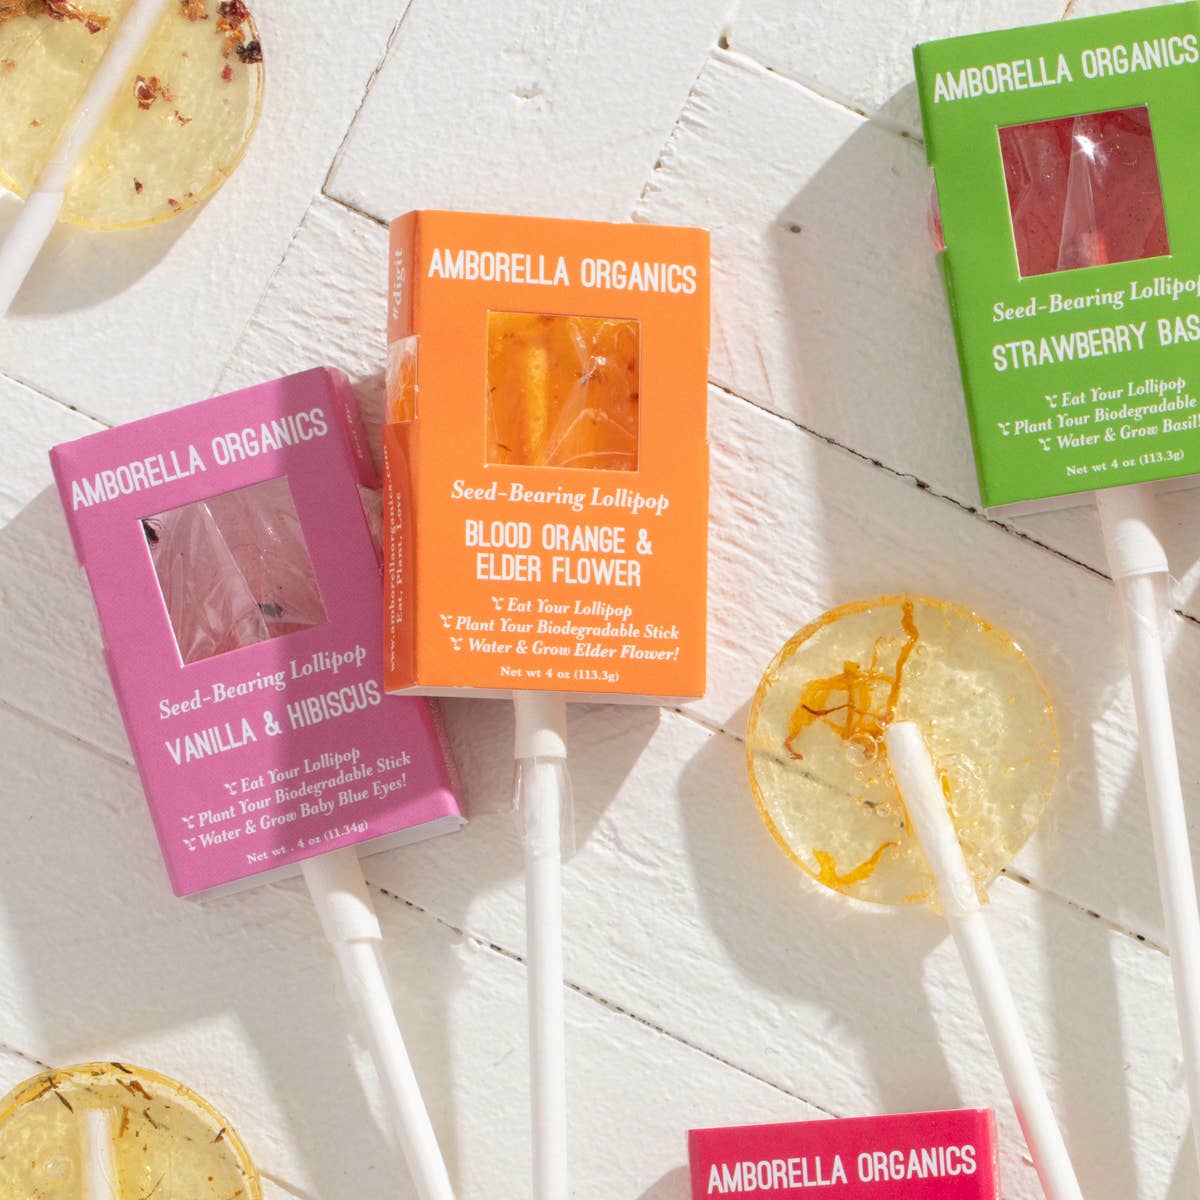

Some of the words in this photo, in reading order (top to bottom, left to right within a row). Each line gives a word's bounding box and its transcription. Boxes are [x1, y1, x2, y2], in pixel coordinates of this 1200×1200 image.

[933, 53, 1073, 104] AMBORELLA
[1080, 34, 1200, 80] ORGANICS
[427, 247, 570, 287] AMBORELLA
[580, 257, 697, 295] ORGANICS
[992, 288, 1126, 323] Seed-Bearing
[992, 321, 1147, 372] STRAWBERRY
[1061, 391, 1087, 408] Eat
[1090, 387, 1124, 403] Your
[1127, 376, 1187, 398] Lollipop
[1056, 433, 1101, 449] Water
[1103, 426, 1117, 443] &
[1119, 424, 1159, 440] Grow
[71, 444, 207, 511] AMBORELLA
[211, 407, 328, 466] ORGANICS
[450, 479, 587, 513] Seed-Bearing
[590, 486, 670, 517] Lollipop
[465, 519, 532, 549] BLOOD
[542, 523, 626, 555] ORANGE
[635, 527, 653, 555] &
[476, 552, 542, 582] ELDER
[552, 555, 641, 588] FLOWER
[468, 637, 513, 654] Water
[515, 639, 529, 655] &
[531, 640, 571, 657] Grow
[573, 642, 618, 659] Elder
[619, 644, 680, 661] Flower!
[159, 670, 287, 721] Seed-Bearing
[289, 644, 367, 680] Lollipop
[500, 666, 523, 678] Net
[526, 669, 542, 678] wt
[545, 668, 554, 679] 4
[556, 671, 571, 679] oz
[573, 669, 620, 684] (113.3g)
[164, 717, 258, 766] VANILLA
[262, 710, 283, 737] &
[286, 679, 382, 730] HIBISCUS
[197, 828, 242, 848] Water
[244, 819, 257, 835] &
[259, 811, 297, 830] Grow
[299, 797, 335, 818] Baby
[338, 789, 369, 807] Blue
[371, 772, 407, 799] Eyes!
[707, 1154, 848, 1195] AMBORELLA
[857, 1144, 977, 1183] ORGANICS
